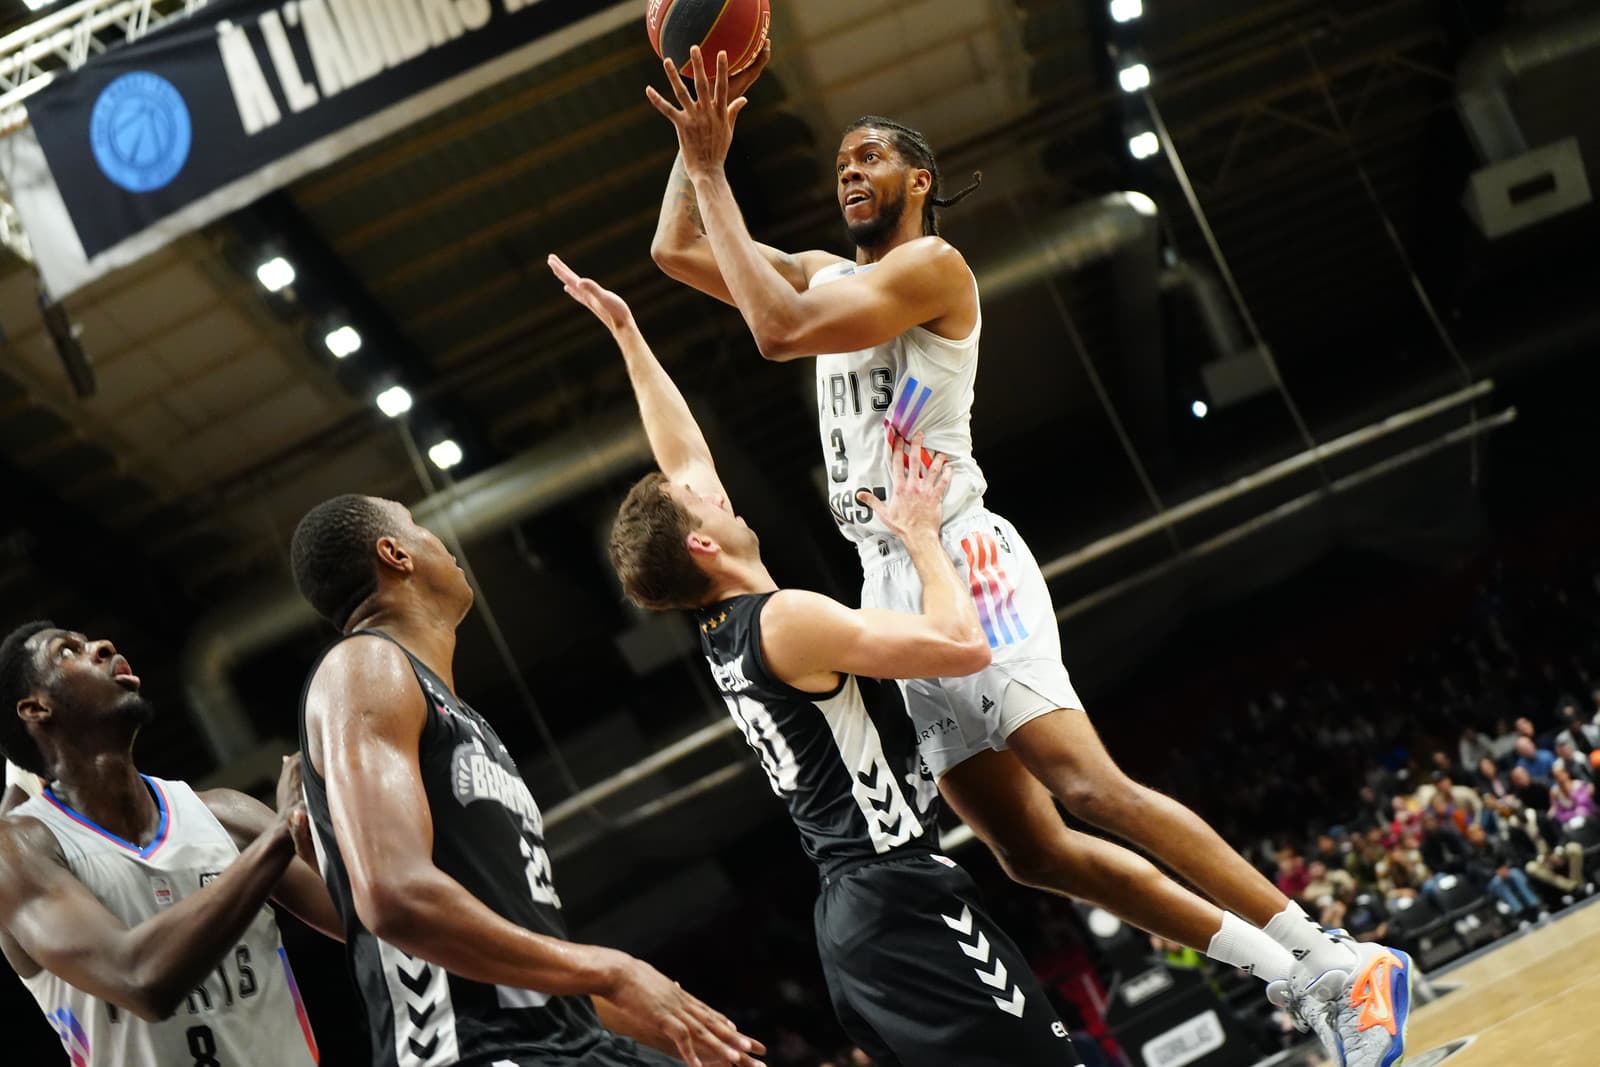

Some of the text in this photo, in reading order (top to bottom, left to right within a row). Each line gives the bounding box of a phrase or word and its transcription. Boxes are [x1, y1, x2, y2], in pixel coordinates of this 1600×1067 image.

[258, 0, 492, 113] L'ADID
[820, 367, 893, 419] RIS
[830, 428, 849, 483] 3
[185, 1025, 221, 1067] 8
